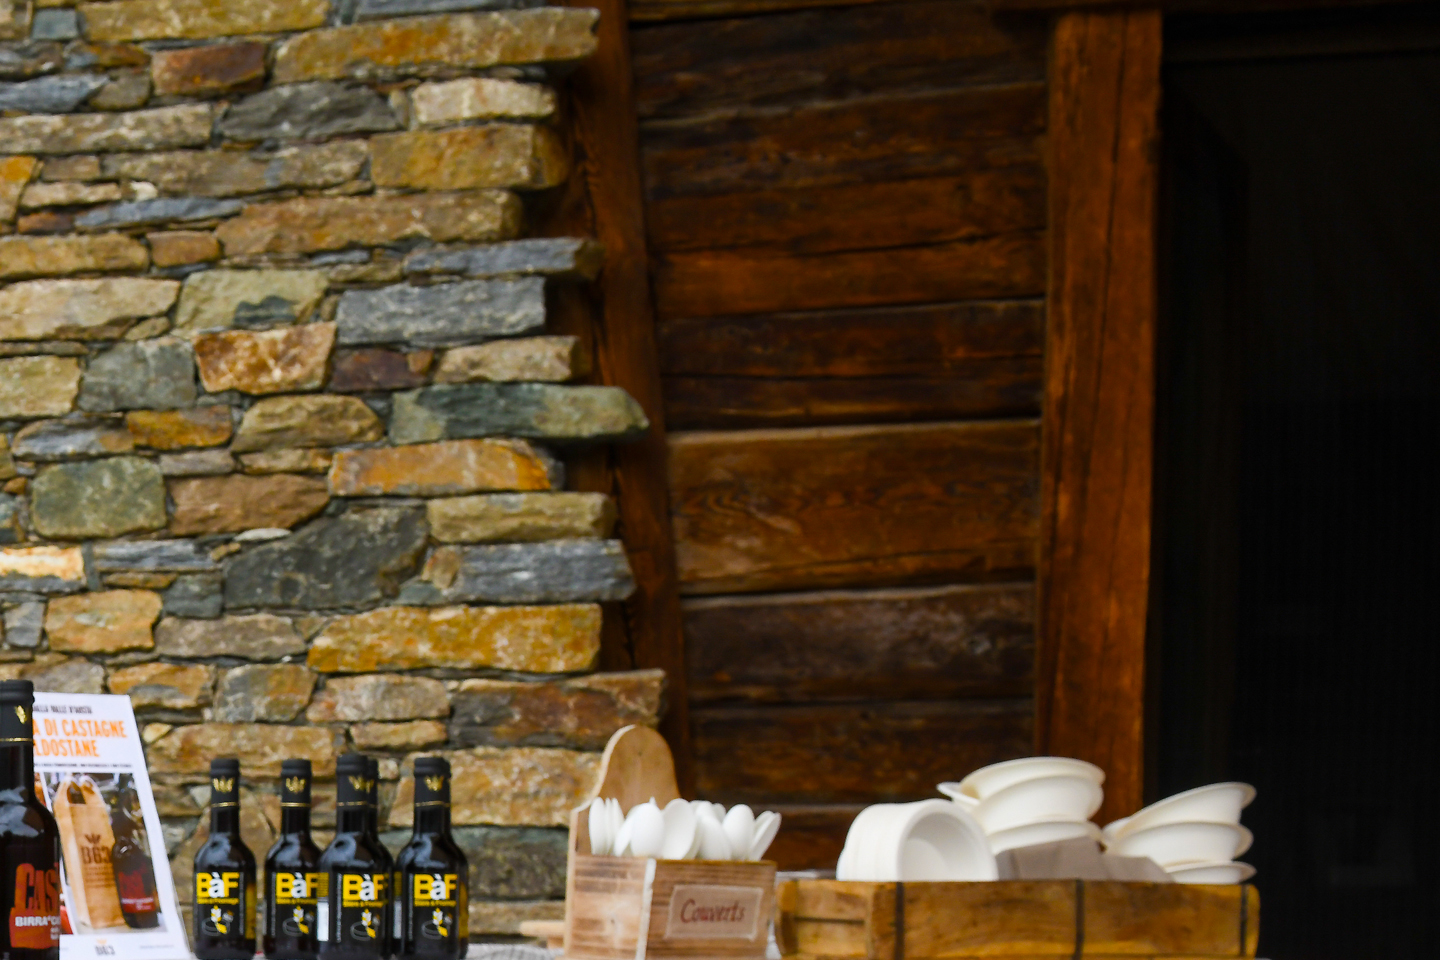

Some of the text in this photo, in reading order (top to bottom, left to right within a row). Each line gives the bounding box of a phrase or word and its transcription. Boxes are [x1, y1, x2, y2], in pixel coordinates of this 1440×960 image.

[44, 718, 59, 736] DI
[61, 719, 128, 738] CASTAGNE
[33, 739, 100, 757] LDOSTANE
[196, 871, 240, 898] BàF
[342, 873, 384, 900] BàF
[414, 873, 458, 900] BàF
[15, 916, 48, 927] BIRRA
